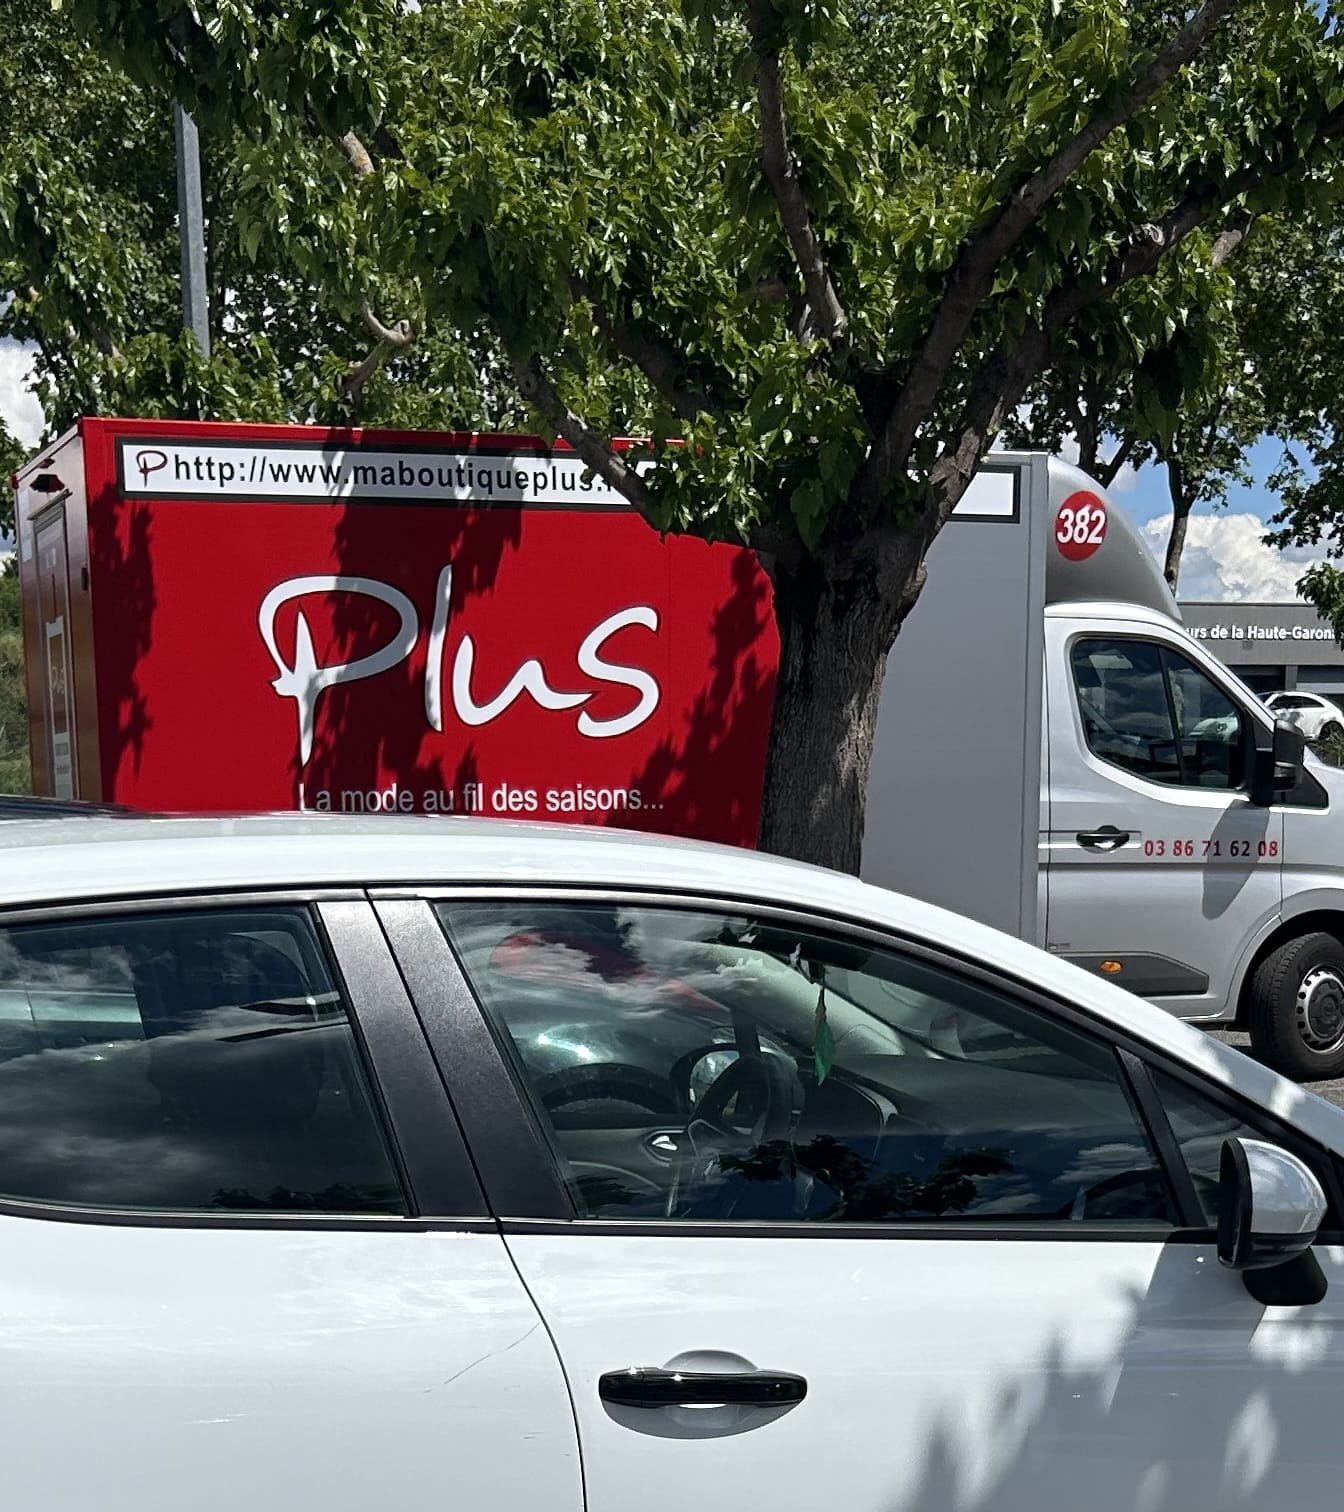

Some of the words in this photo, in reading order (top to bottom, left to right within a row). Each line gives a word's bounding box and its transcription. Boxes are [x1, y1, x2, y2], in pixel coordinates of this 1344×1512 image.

[1057, 503, 1106, 545] 382
[1210, 625, 1228, 639] de
[1232, 625, 1244, 640] la
[1248, 625, 1344, 640] Haute-Garon
[258, 563, 661, 767] Plus
[299, 783, 330, 812] La
[341, 783, 414, 812] mode
[423, 789, 454, 812] au
[463, 783, 483, 812] fil
[492, 783, 538, 812] des
[546, 783, 665, 812] saisons...
[1144, 840, 1165, 857] 03
[1173, 840, 1194, 857] 86
[1201, 840, 1221, 857] 71
[1230, 840, 1250, 857] 62
[1258, 840, 1278, 857] 08
